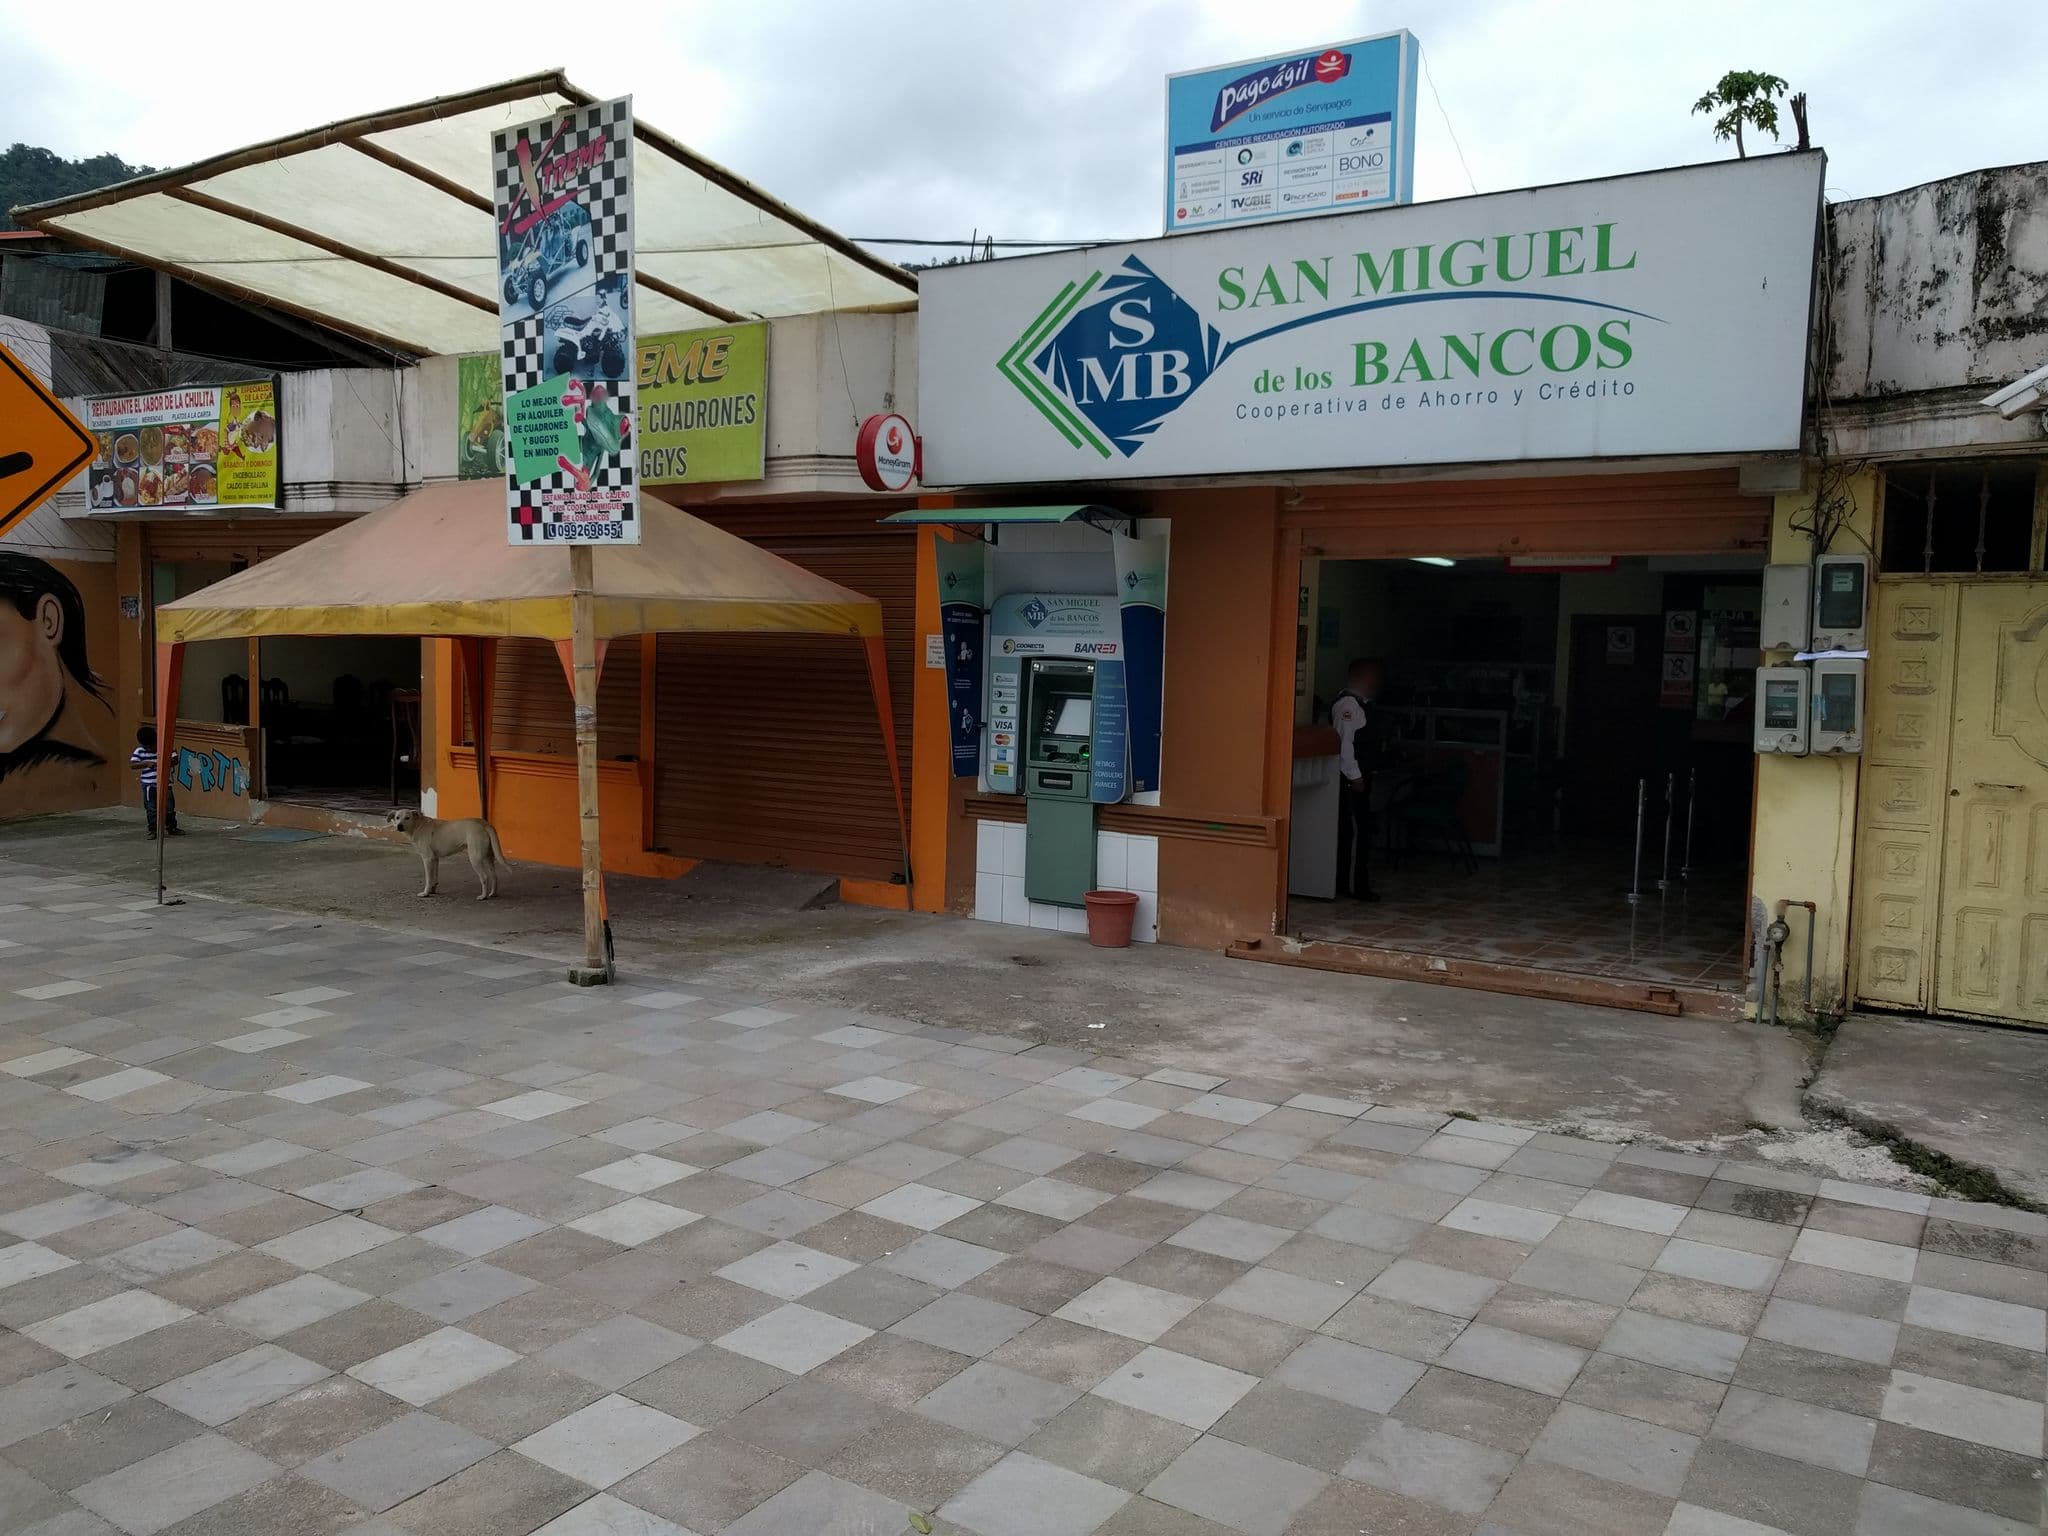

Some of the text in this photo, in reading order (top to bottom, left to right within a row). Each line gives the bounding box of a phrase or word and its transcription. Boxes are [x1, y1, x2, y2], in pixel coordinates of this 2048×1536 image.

[1250, 98, 1352, 123] Un servicio de Servipagos
[1215, 137, 1242, 149] CENTRO
[1243, 135, 1251, 144] DE
[1302, 121, 1345, 136] AUTORIZADO
[1340, 152, 1384, 171] BONO
[1218, 222, 1637, 313] SAN MIGUEL
[1109, 296, 1155, 350] S
[1254, 319, 1633, 394] de los BANCOS
[1077, 350, 1193, 405] MB
[92, 390, 215, 418] RESTAURANTE EL SABOR DE LA CHULITA
[521, 396, 558, 408] LO MEJOR
[1236, 379, 1634, 421] Cooperativa de Ahorro y Crédito
[516, 408, 564, 421] EN ALQUILER
[650, 394, 756, 433] CUADRONES
[513, 420, 569, 434] DE CUADRONES
[522, 434, 559, 445] Y BUGGYS
[523, 447, 559, 458] EN MINDO
[878, 455, 911, 468] MoneyGram
[542, 493, 570, 502] ESTAMOS
[592, 491, 604, 500] DEL
[605, 488, 631, 500] CAJERO
[557, 523, 623, 537] 0992698551
[1031, 603, 1040, 611] S
[1047, 599, 1101, 607] SAN MIGUEL
[1027, 611, 1044, 621] MB
[1067, 614, 1100, 622] BANCOS
[1709, 609, 1746, 622] CAJA
[994, 720, 1013, 729] VISA
[1095, 760, 1116, 768] RETIROS
[1094, 770, 1124, 779] CONSULTAS
